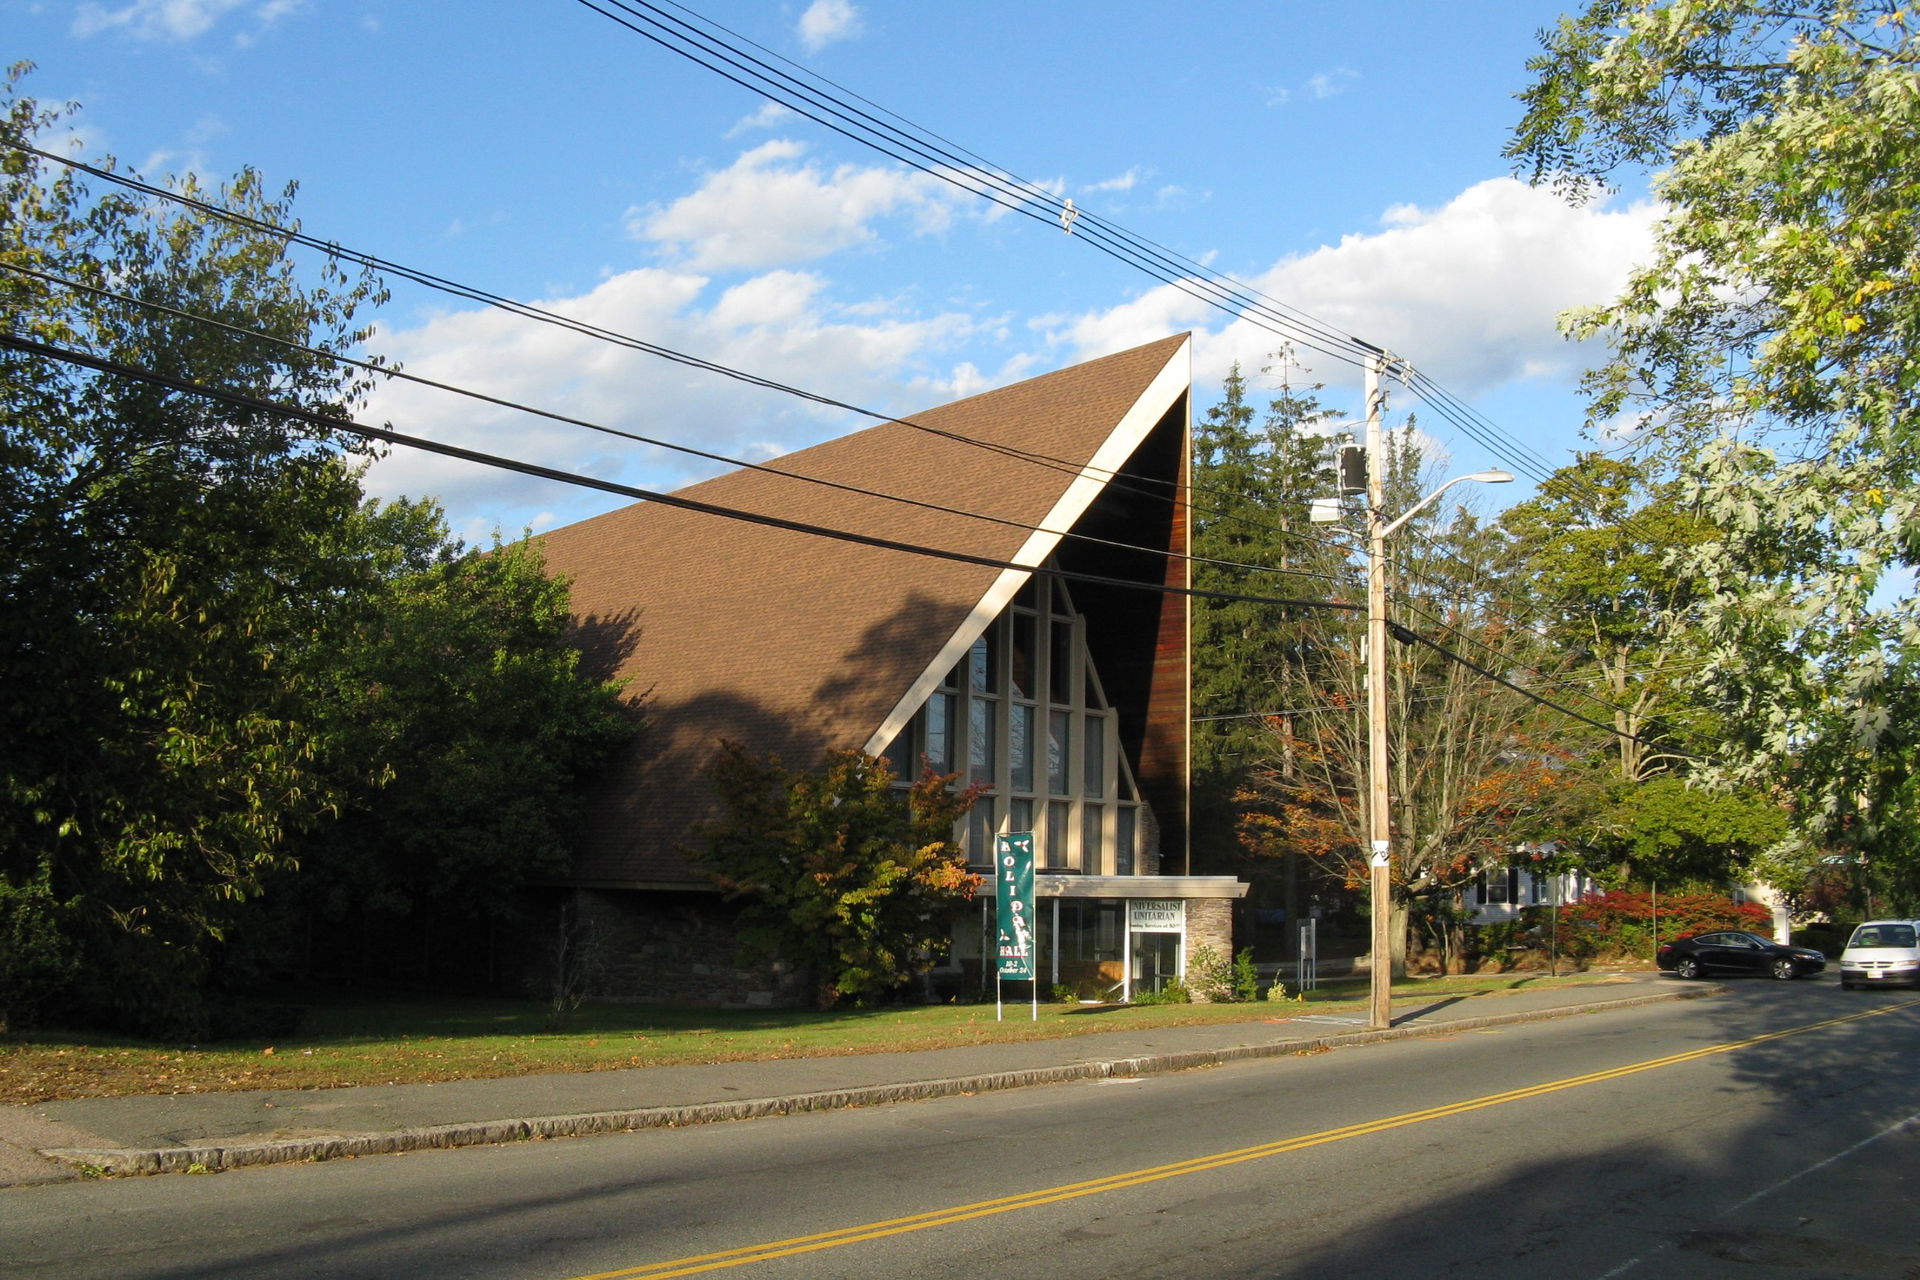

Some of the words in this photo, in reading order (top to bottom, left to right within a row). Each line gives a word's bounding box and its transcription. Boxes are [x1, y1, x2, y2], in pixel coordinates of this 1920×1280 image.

[1131, 901, 1181, 912] NIVERSALIST
[1134, 911, 1175, 921] UNITARIAN
[999, 945, 1028, 957] HALL
